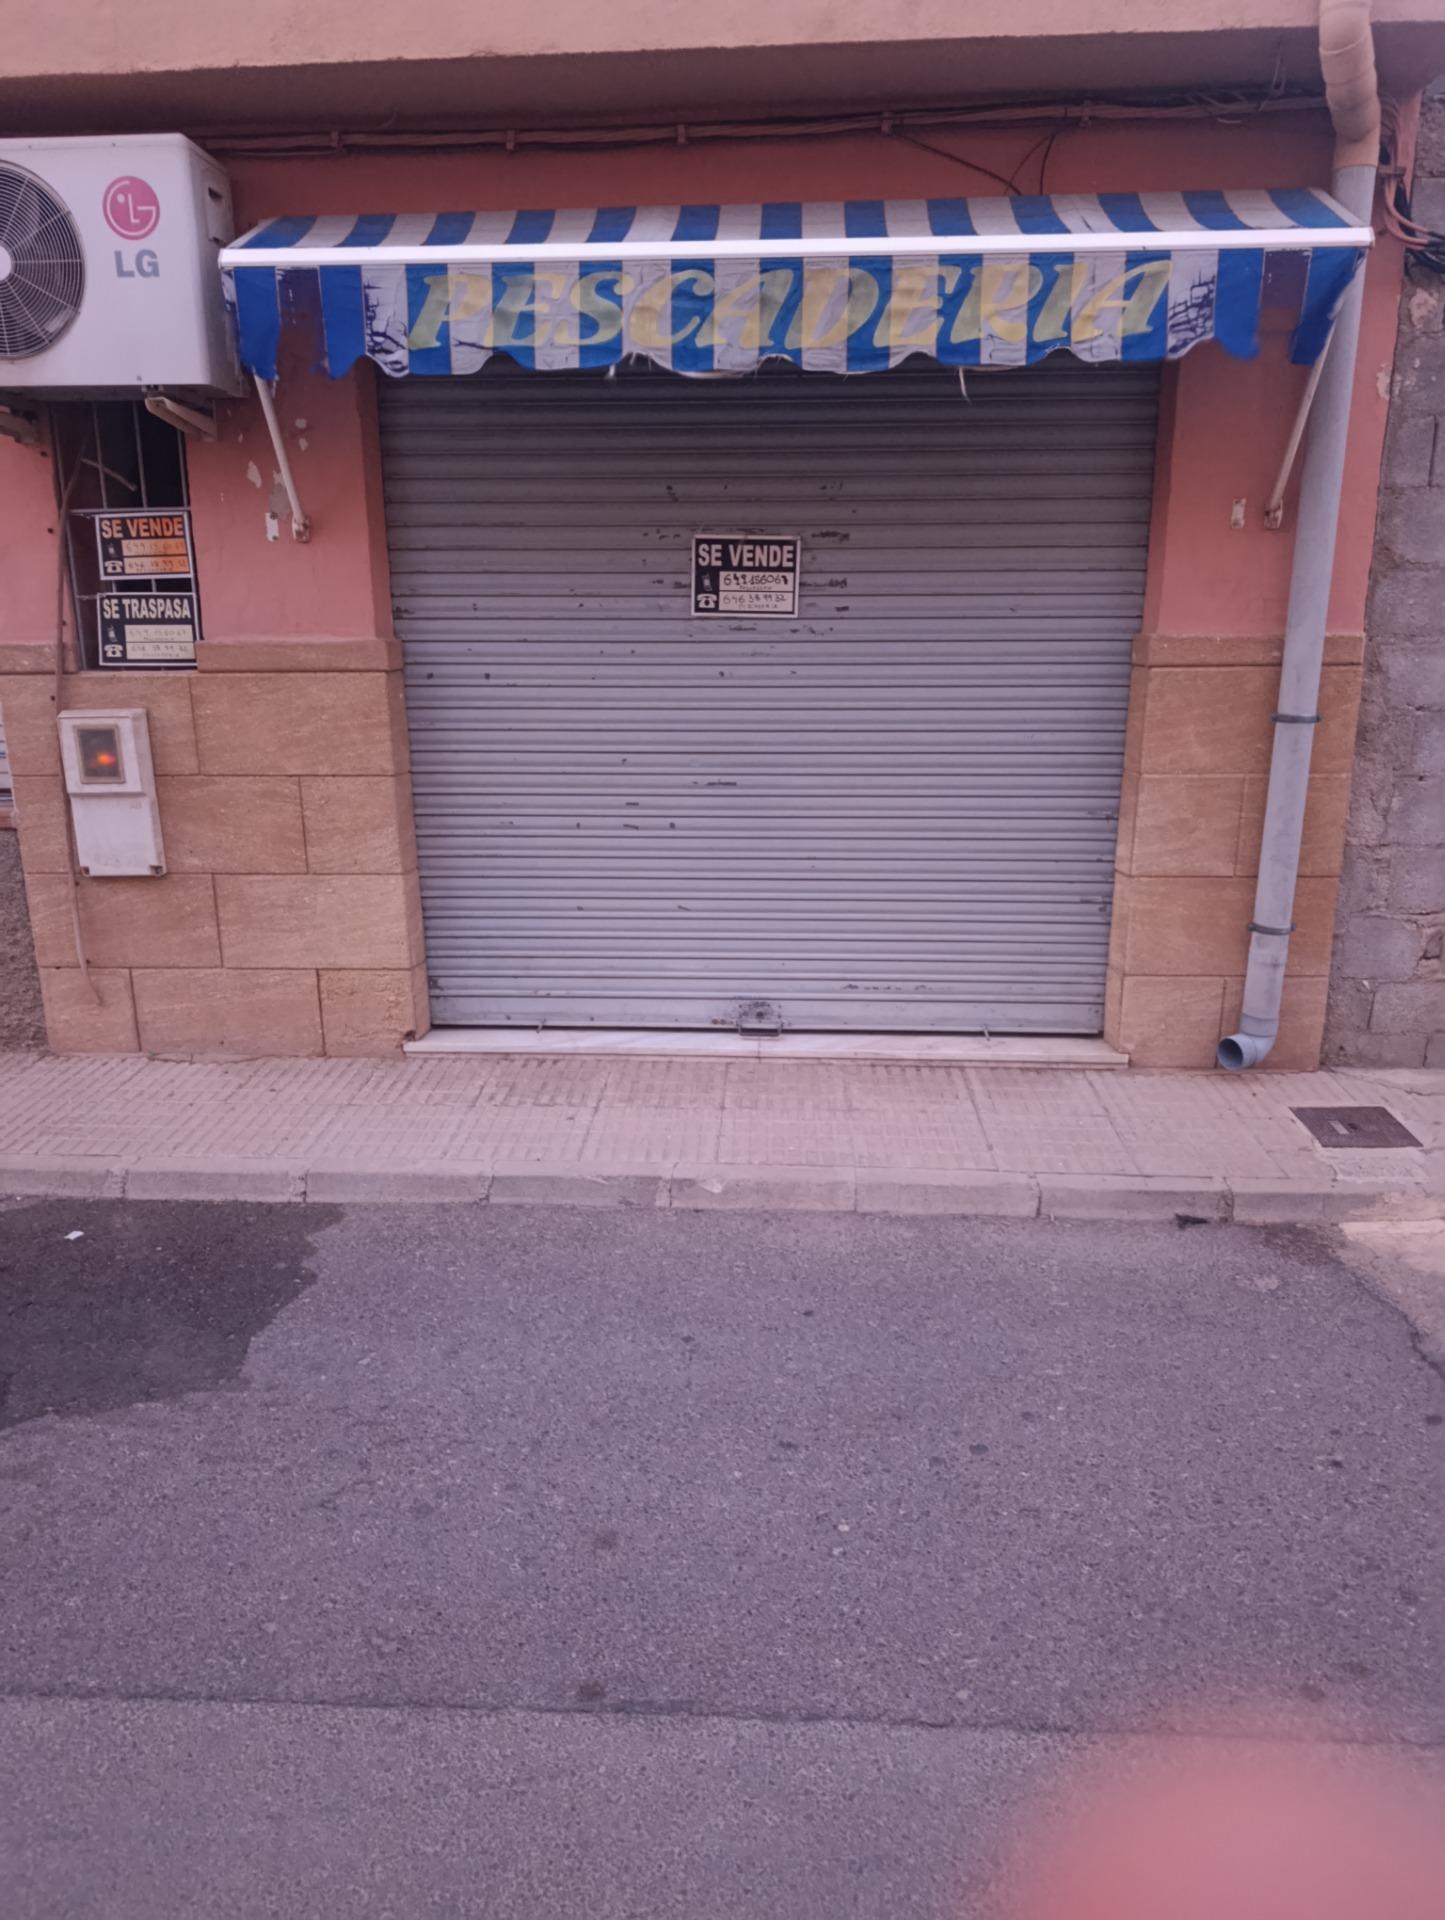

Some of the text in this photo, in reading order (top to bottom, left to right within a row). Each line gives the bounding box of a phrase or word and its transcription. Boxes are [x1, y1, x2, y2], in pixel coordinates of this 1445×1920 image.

[114, 249, 160, 278] LG
[407, 259, 1173, 350] PESCADERIA
[101, 517, 184, 539] SE VENDE
[697, 543, 794, 567] SE VENDE
[102, 597, 192, 619] SE TRASPASA
